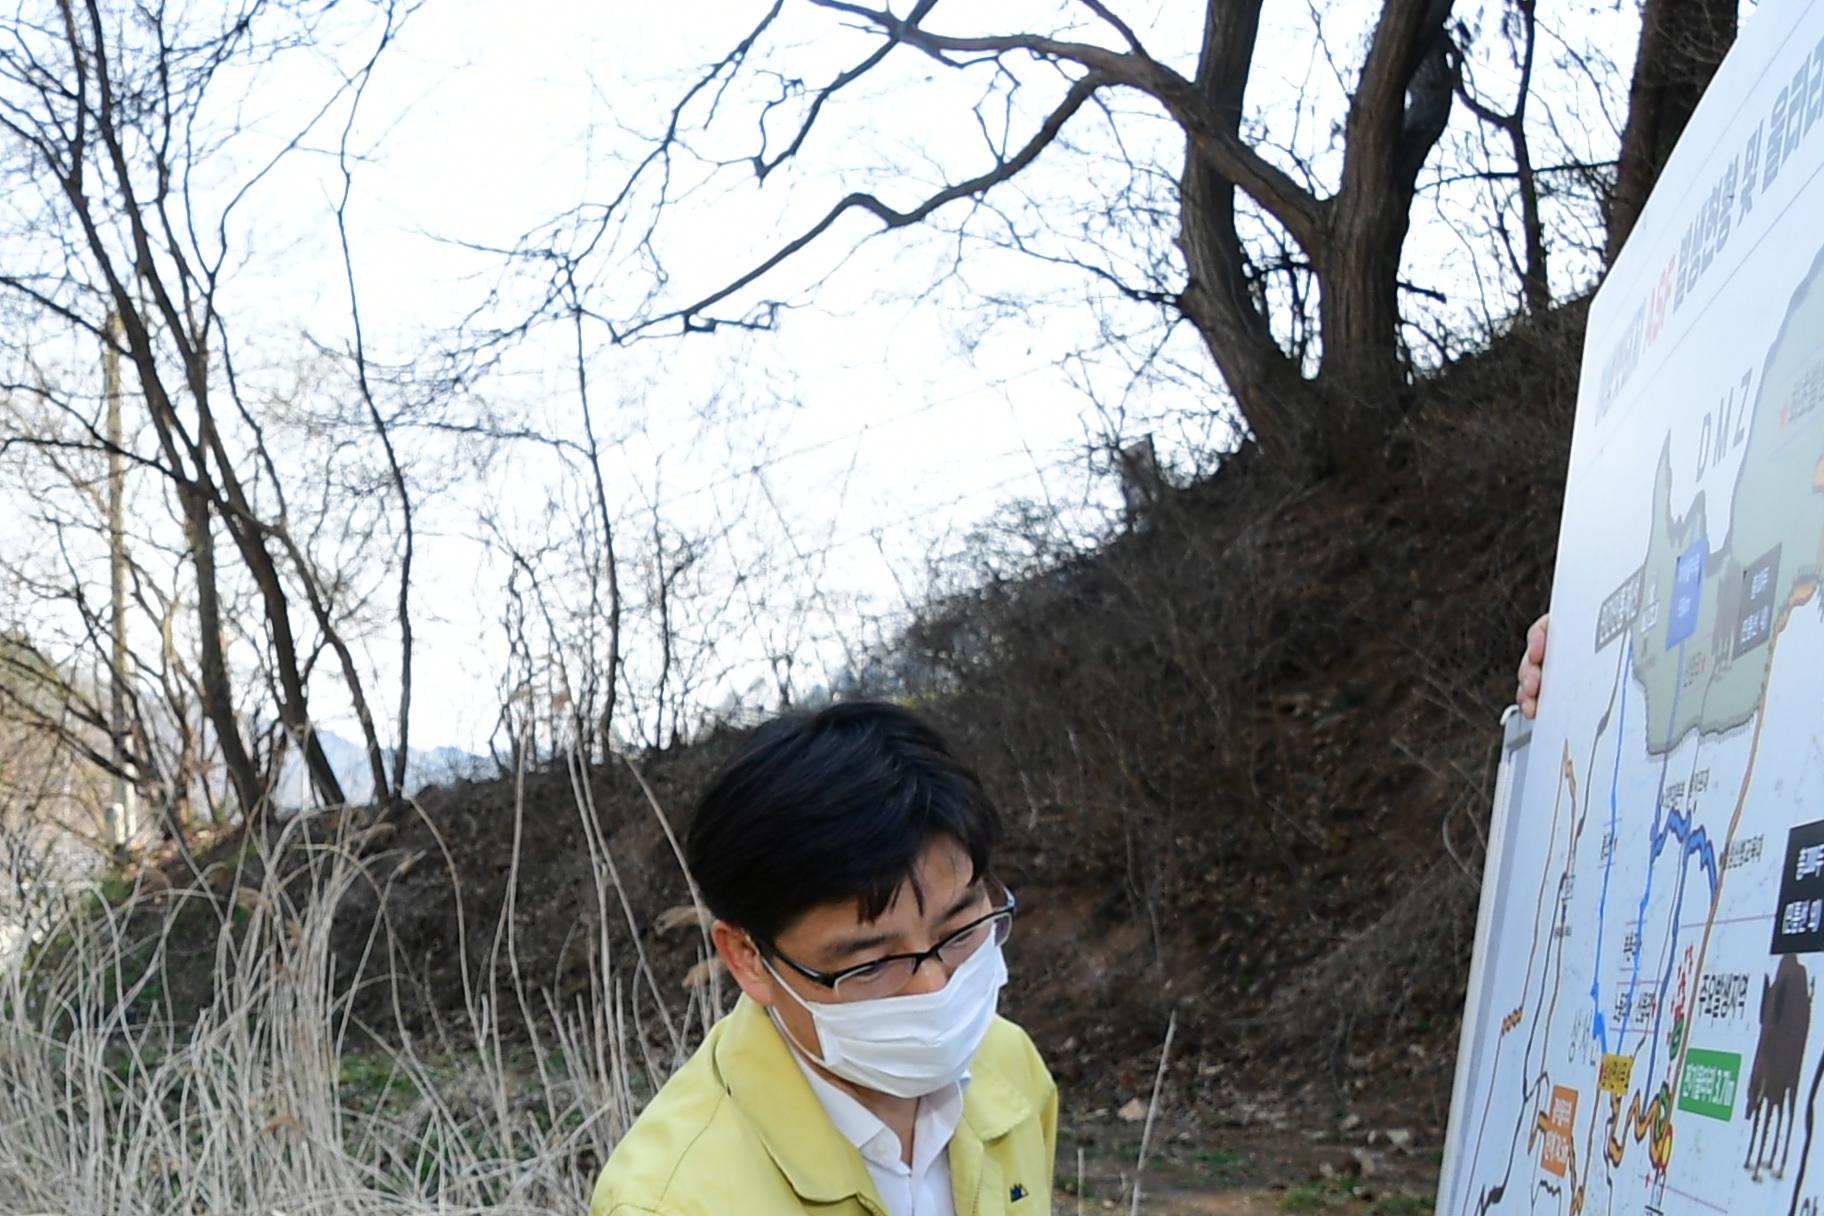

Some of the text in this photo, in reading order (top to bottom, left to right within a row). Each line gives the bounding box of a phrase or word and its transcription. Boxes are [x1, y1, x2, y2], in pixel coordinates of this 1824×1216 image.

[1674, 152, 1739, 314] 발생현황
[1737, 118, 1765, 228] 및
[1696, 367, 1753, 482] DMZ
[1699, 973, 1750, 1020] 주요발생지역
